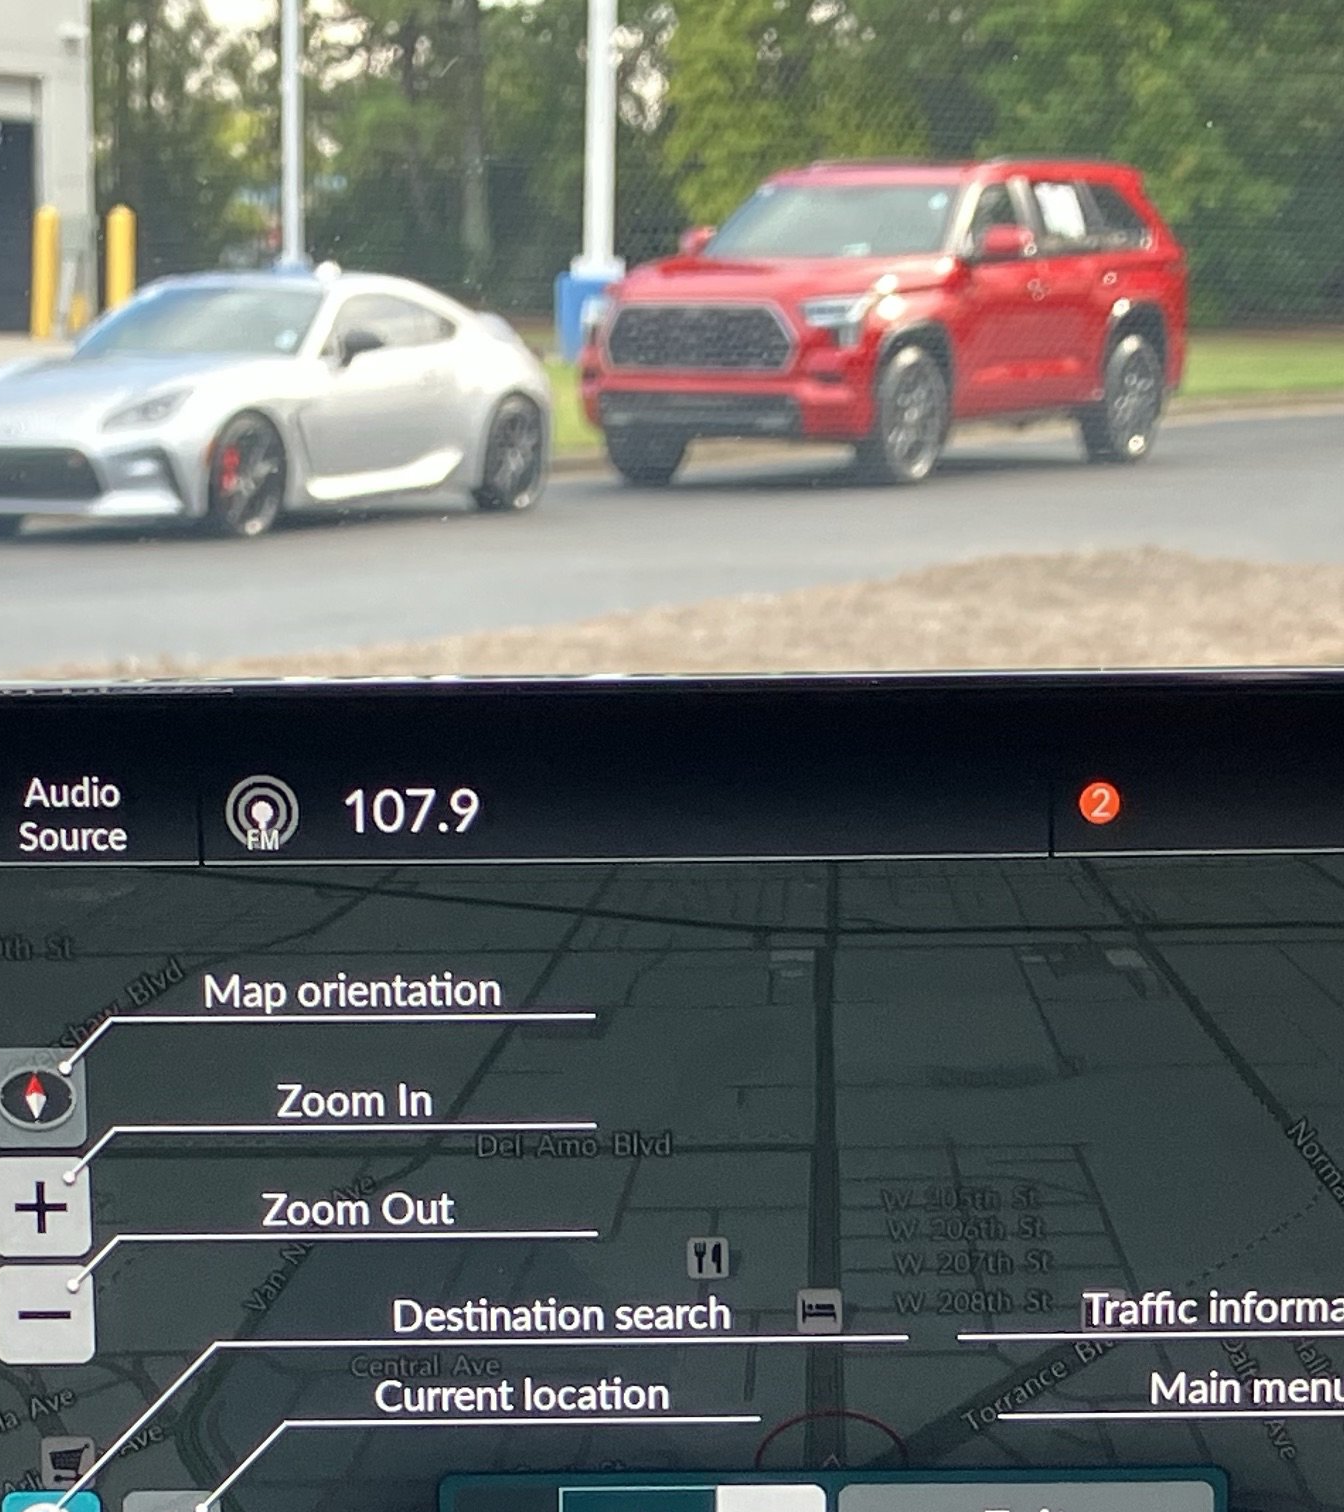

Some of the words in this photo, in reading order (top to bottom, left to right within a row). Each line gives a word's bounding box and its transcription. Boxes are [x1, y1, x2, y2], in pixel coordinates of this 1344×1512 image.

[23, 776, 121, 808] Audio
[1091, 788, 1111, 818] 2
[344, 787, 480, 834] 107.9
[19, 821, 128, 852] Source
[246, 828, 279, 851] FM
[128, 958, 184, 1006] Blvd
[204, 973, 287, 1012] Map
[297, 971, 501, 1008] orientation
[277, 1084, 383, 1118] Zoom
[398, 1083, 433, 1117] In
[477, 1134, 523, 1157] Del
[538, 1135, 598, 1157] Amo
[614, 1132, 672, 1157] Blvd
[262, 1193, 370, 1227] Zoom
[381, 1192, 455, 1226] Out
[939, 1251, 1013, 1275] 207th
[245, 1271, 287, 1311] Van
[939, 1290, 1013, 1314] 208th
[1082, 1290, 1198, 1326] Traffic
[393, 1296, 605, 1333] Destination
[615, 1295, 731, 1331] search
[352, 1354, 440, 1378] Central
[456, 1355, 501, 1378] Ave
[29, 1388, 75, 1419] Ave
[374, 1378, 514, 1413] Current
[524, 1375, 670, 1411] location
[960, 1360, 1068, 1431] Torrance
[1151, 1369, 1241, 1405] Main
